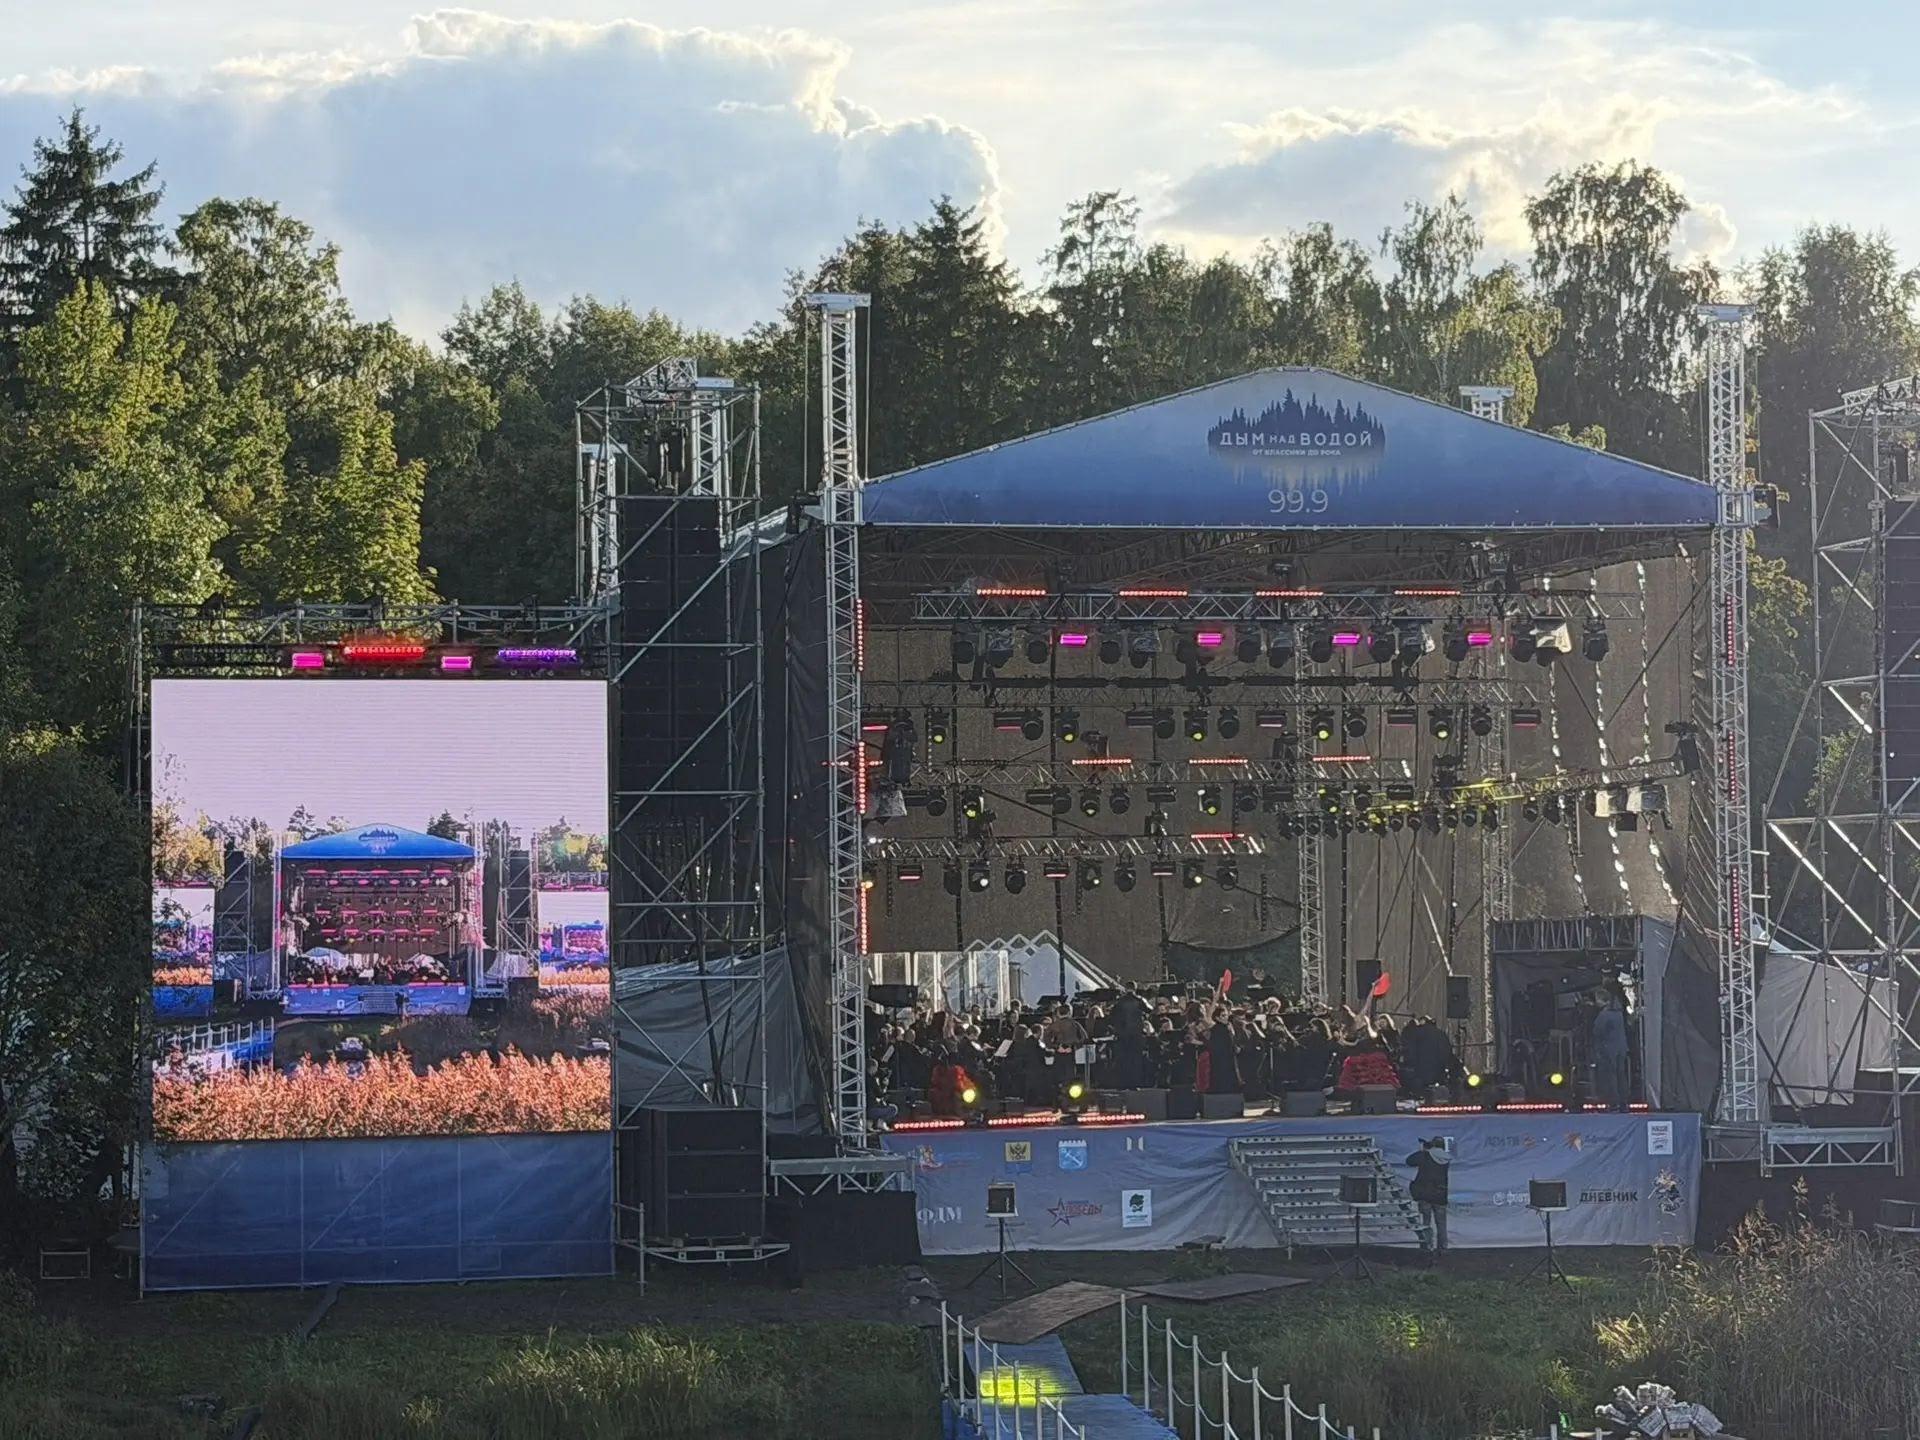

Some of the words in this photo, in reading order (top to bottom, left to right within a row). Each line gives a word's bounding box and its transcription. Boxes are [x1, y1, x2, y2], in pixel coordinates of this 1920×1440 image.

[1219, 432, 1264, 446] ДЫМ
[1269, 434, 1296, 444] НАД
[1300, 431, 1372, 446] ВОДОЙ
[1268, 489, 1329, 513] 99.9
[1580, 1191, 1638, 1202] ДНЕВНИК
